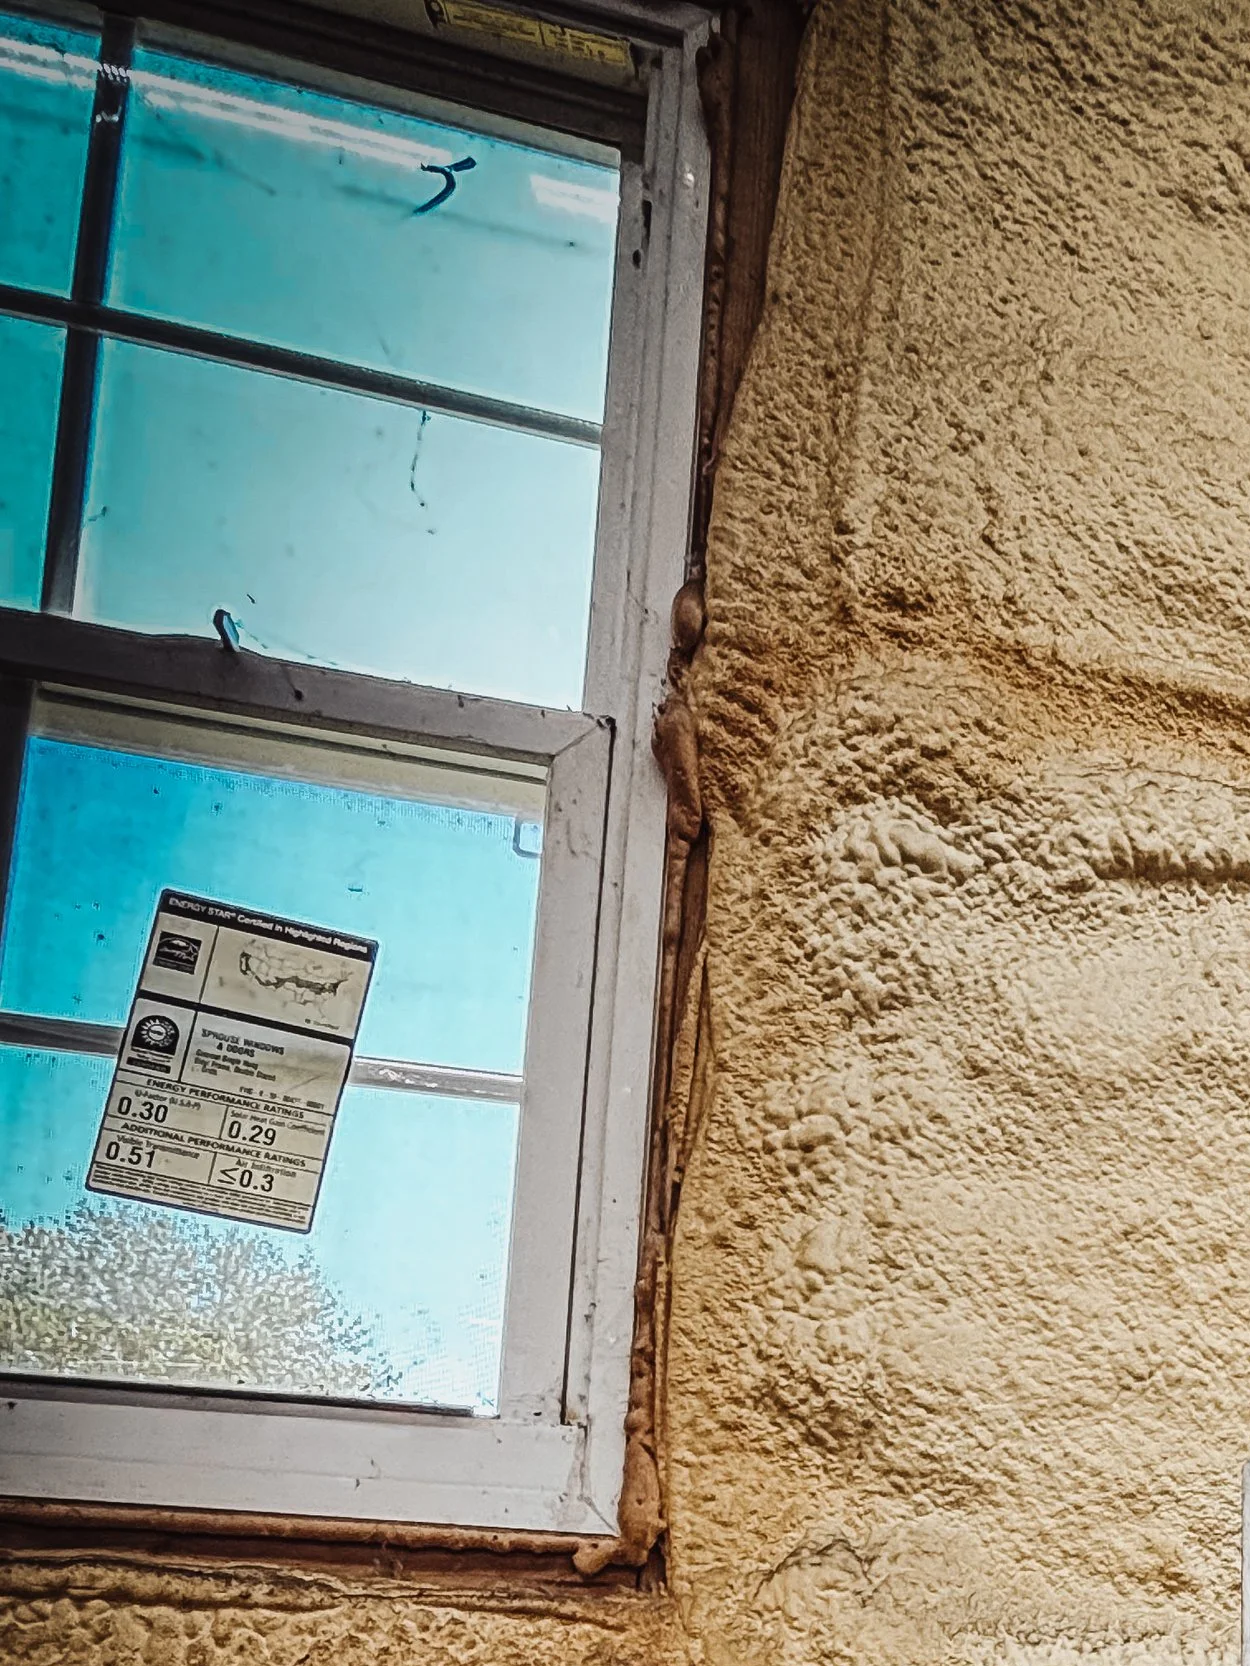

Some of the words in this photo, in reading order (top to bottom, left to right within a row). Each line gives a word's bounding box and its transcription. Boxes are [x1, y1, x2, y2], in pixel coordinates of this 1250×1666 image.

[116, 1096, 168, 1123] 0.30
[147, 1079, 185, 1092] ENERGY
[189, 1088, 259, 1108] PERFORMANCE
[264, 1105, 304, 1118] RATINGS
[121, 1123, 185, 1141] ADDITIONAL
[187, 1137, 260, 1157] PERFORMANCE
[264, 1153, 305, 1166] RATINGS
[227, 1120, 277, 1146] 0.29
[104, 1142, 156, 1167] 0.51
